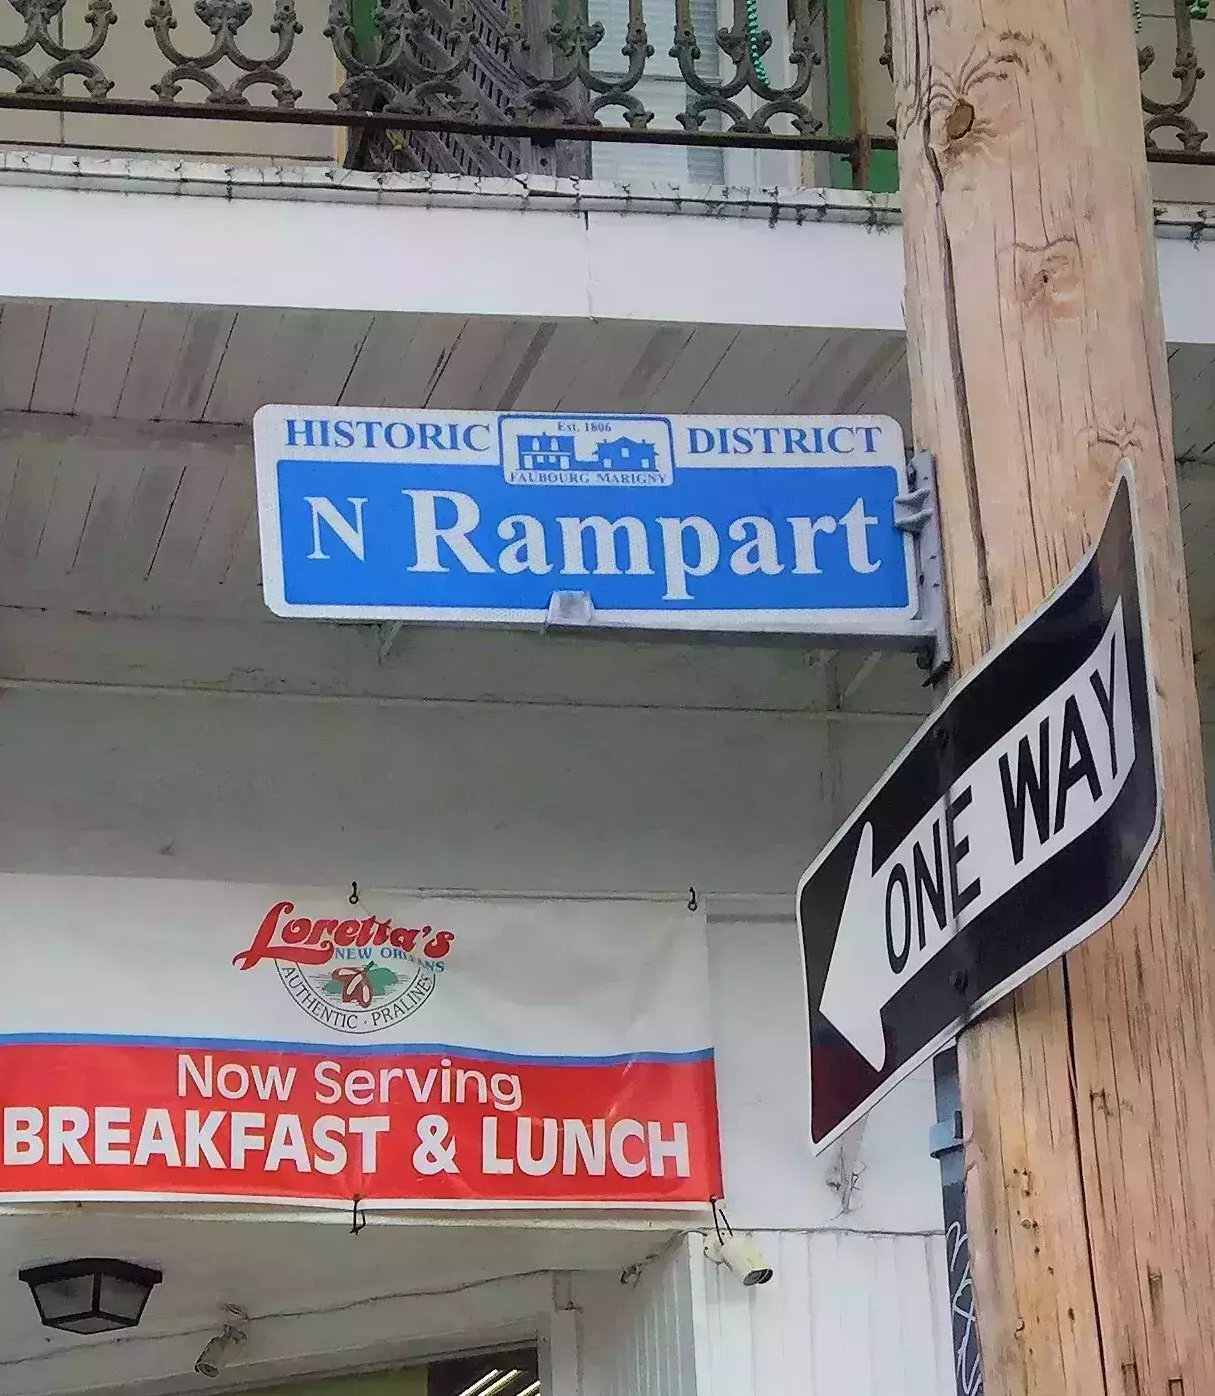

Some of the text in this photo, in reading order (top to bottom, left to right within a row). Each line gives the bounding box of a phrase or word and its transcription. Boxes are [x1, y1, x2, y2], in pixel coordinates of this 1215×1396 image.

[285, 419, 882, 456] HISTORIC DISTRICT
[585, 422, 612, 432] 1806
[510, 472, 667, 484] FAUBOURG MARIGNY
[303, 489, 883, 600] N Rampart
[885, 630, 1124, 976] ONE WAY
[232, 901, 455, 970] Loretta's
[335, 947, 446, 973] NEW ORNS
[282, 967, 430, 1029] AUTHENTIC PRALINES
[176, 1055, 522, 1112] Now Serving
[2, 1106, 691, 1178] BREAKFAST & LUNCH
